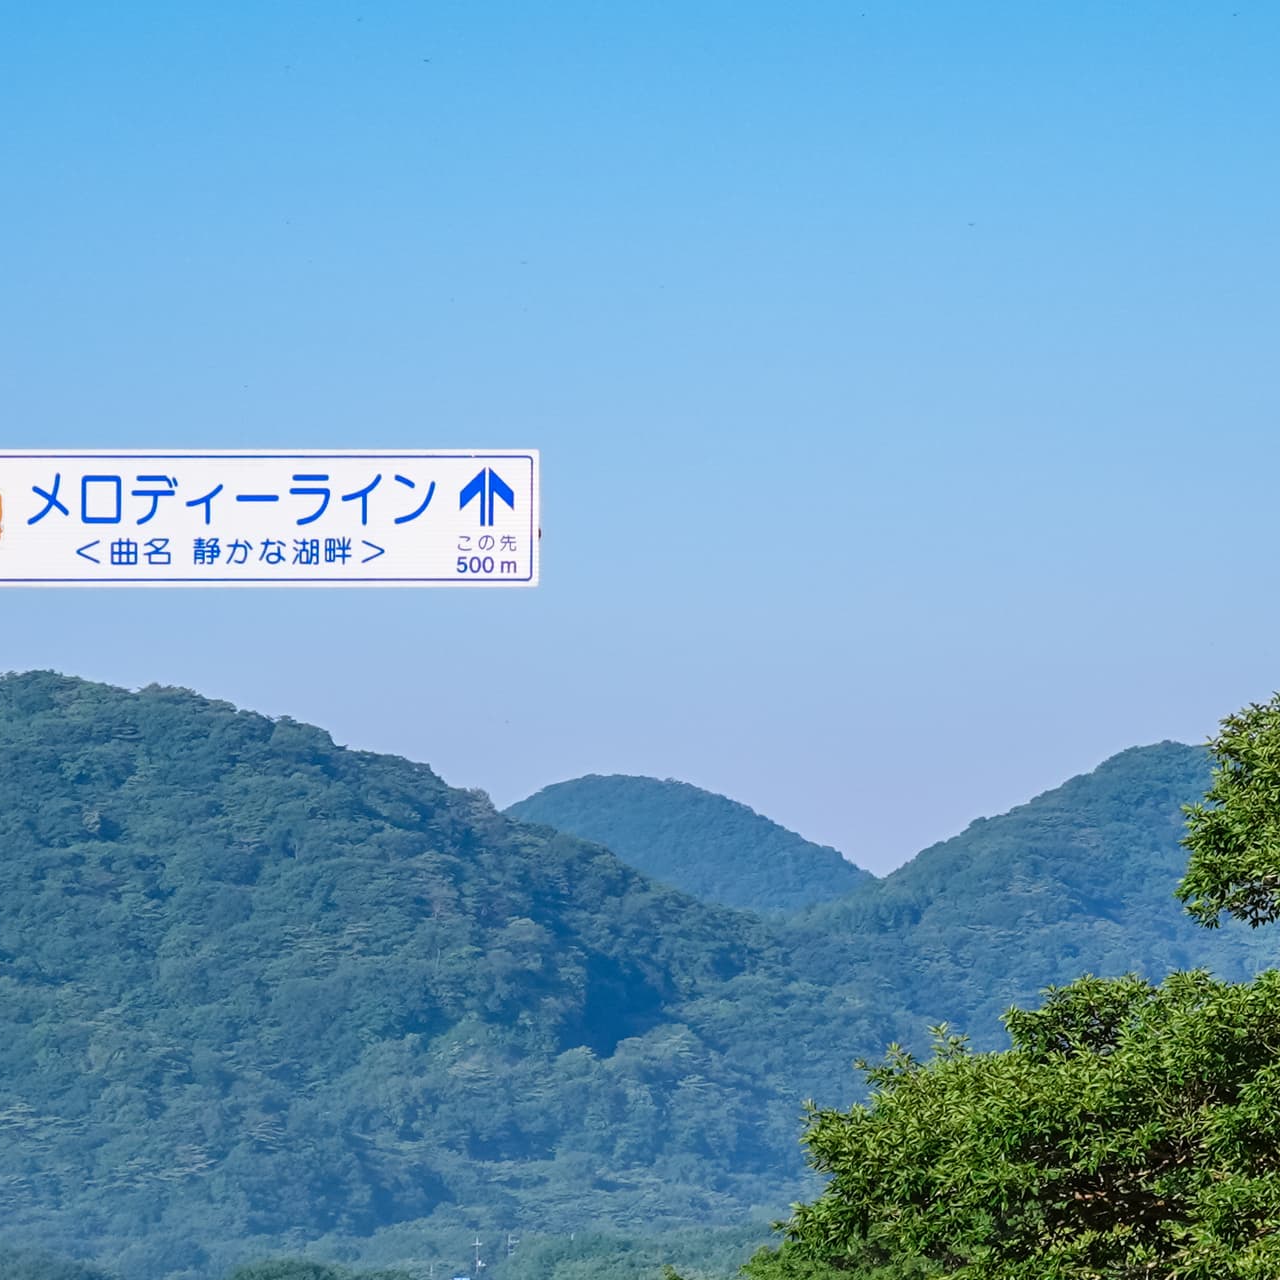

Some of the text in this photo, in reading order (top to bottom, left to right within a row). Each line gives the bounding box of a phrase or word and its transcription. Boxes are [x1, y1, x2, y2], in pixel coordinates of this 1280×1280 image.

[27, 472, 436, 526] メロディーライン
[456, 534, 518, 552] この先
